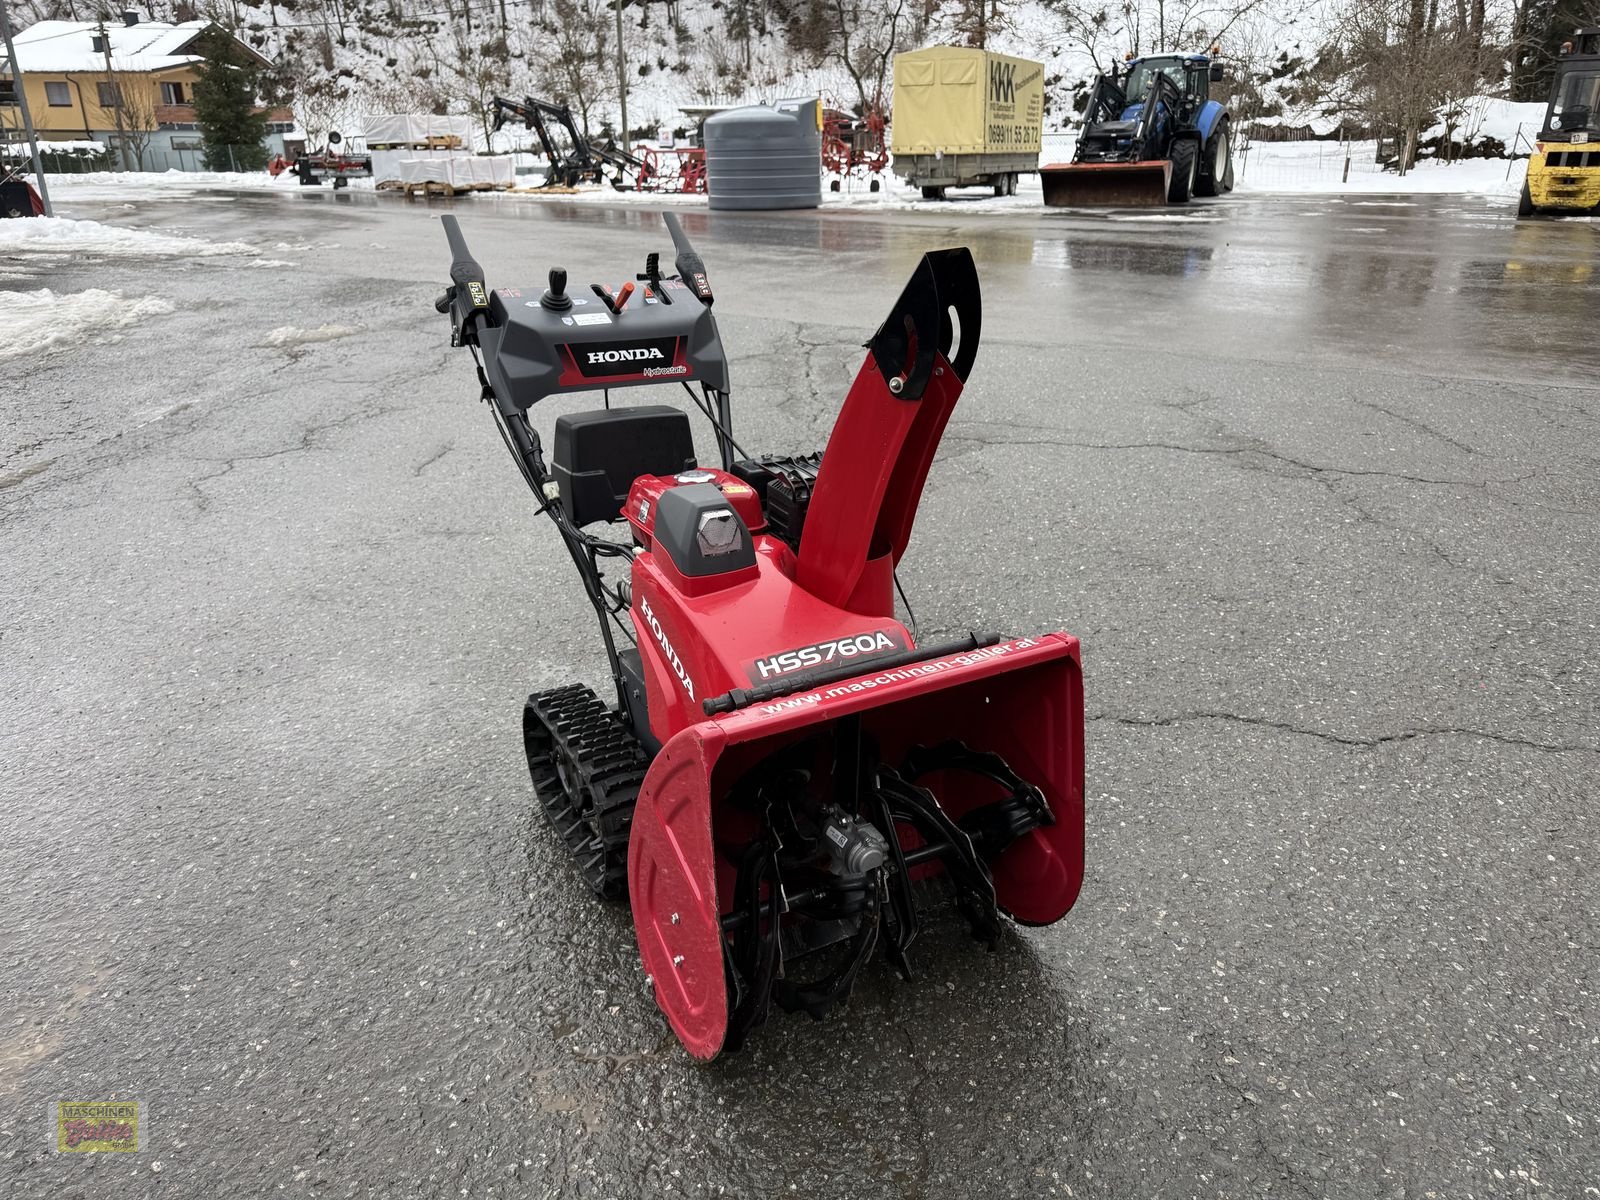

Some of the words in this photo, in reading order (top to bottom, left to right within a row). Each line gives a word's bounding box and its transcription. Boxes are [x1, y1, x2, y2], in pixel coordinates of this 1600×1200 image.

[990, 60, 1016, 103] KKK
[989, 125, 1013, 143] 0699/11
[1015, 126, 1022, 143] 55
[1031, 126, 1038, 143] 72
[587, 348, 664, 364] HONDA
[643, 365, 687, 377] Hydrostatic
[641, 595, 695, 703] HONDA
[757, 632, 895, 679] HSS760A
[763, 637, 1039, 716] www.maschinen-gailer.at
